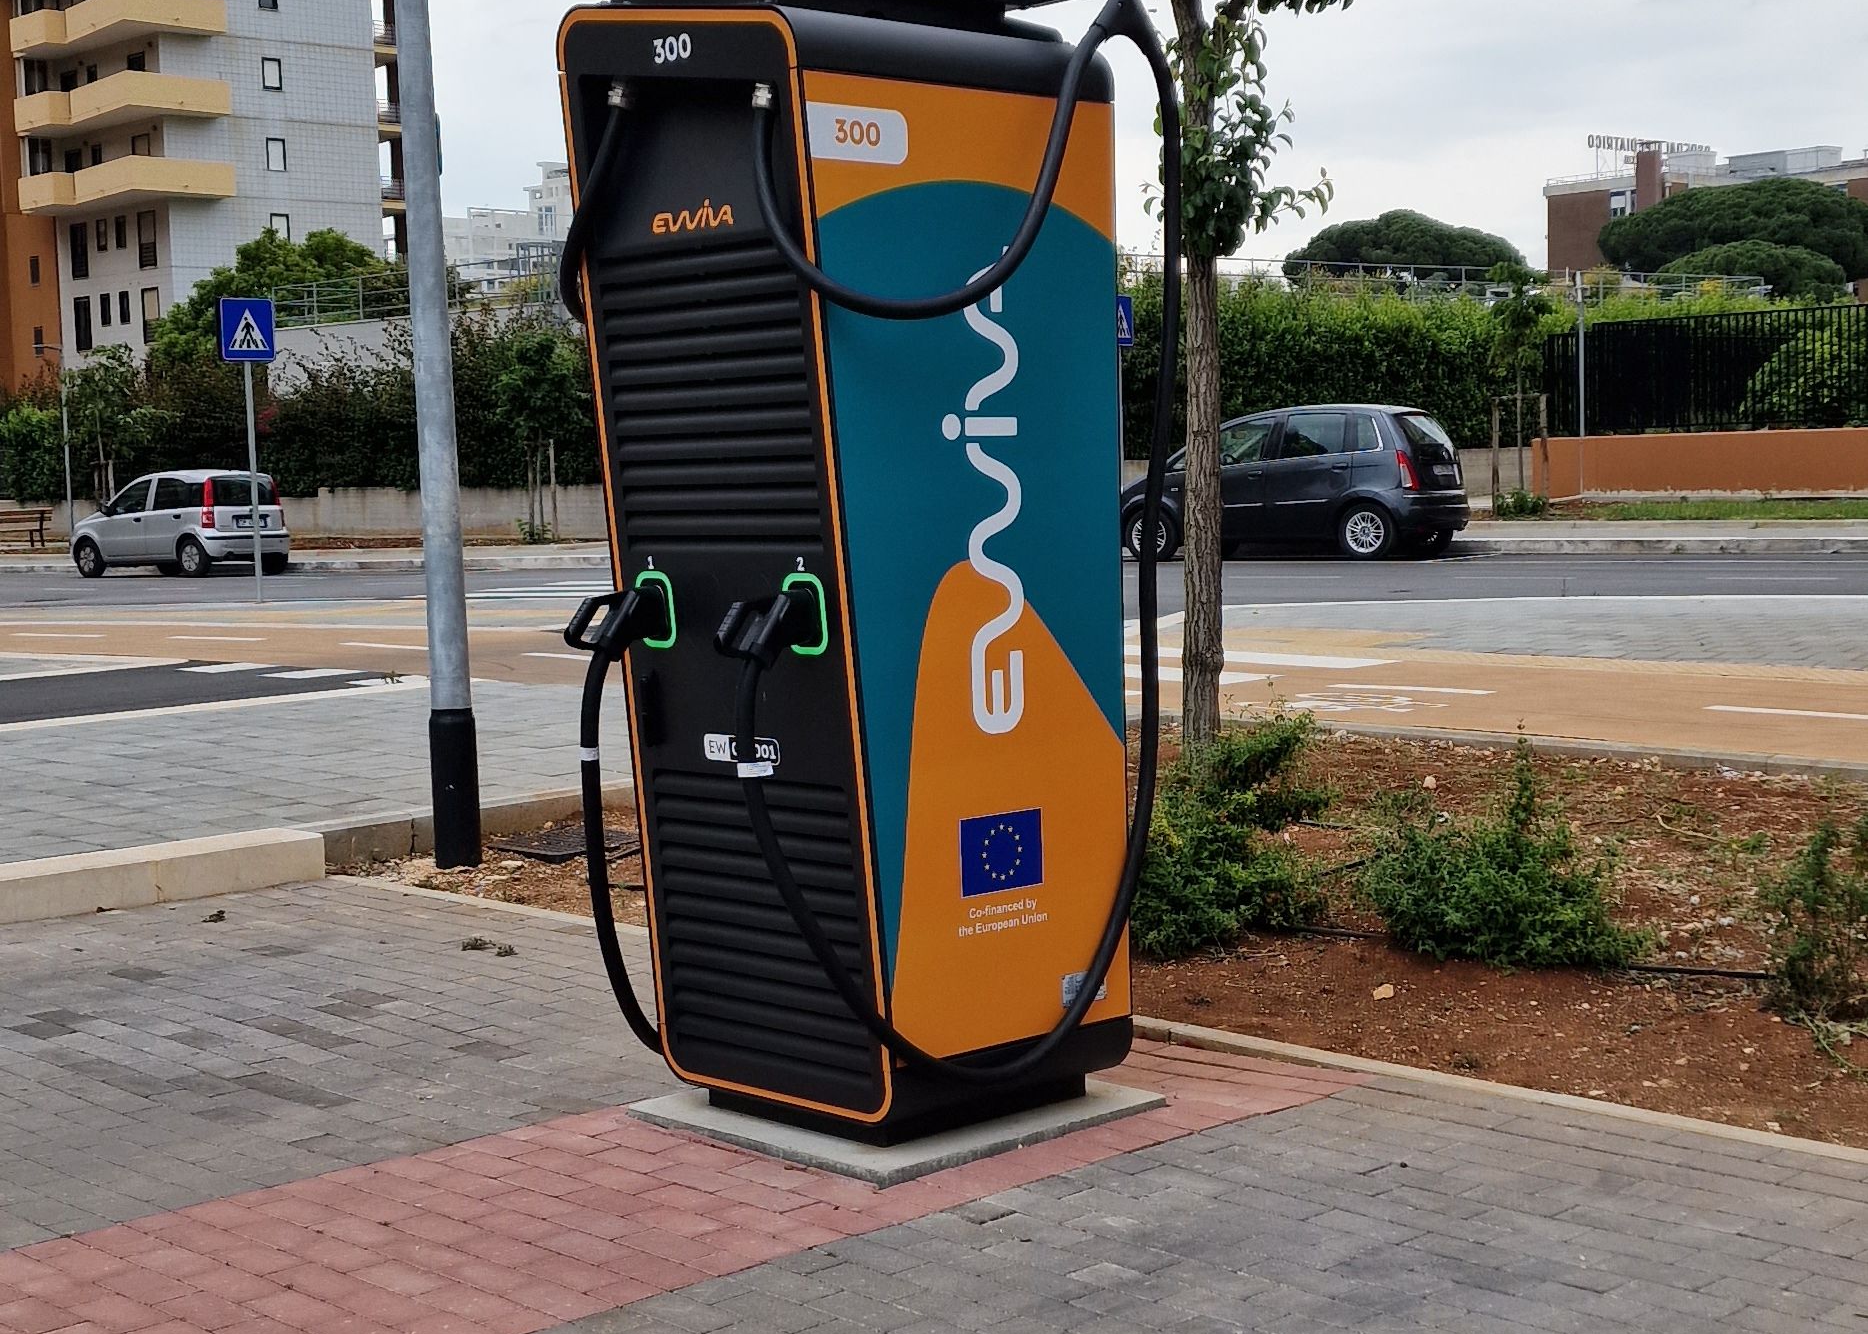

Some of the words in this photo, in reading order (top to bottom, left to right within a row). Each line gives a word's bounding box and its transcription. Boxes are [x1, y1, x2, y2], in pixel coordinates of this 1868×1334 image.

[653, 33, 692, 64] 300
[834, 117, 881, 147] 300
[647, 555, 655, 570] 1
[795, 556, 805, 572] 2
[708, 739, 726, 754] EW
[969, 898, 1024, 919] Co-financed
[1026, 898, 1037, 910] by
[958, 925, 974, 937] the
[975, 918, 1020, 934] European
[1021, 912, 1048, 925] Union
